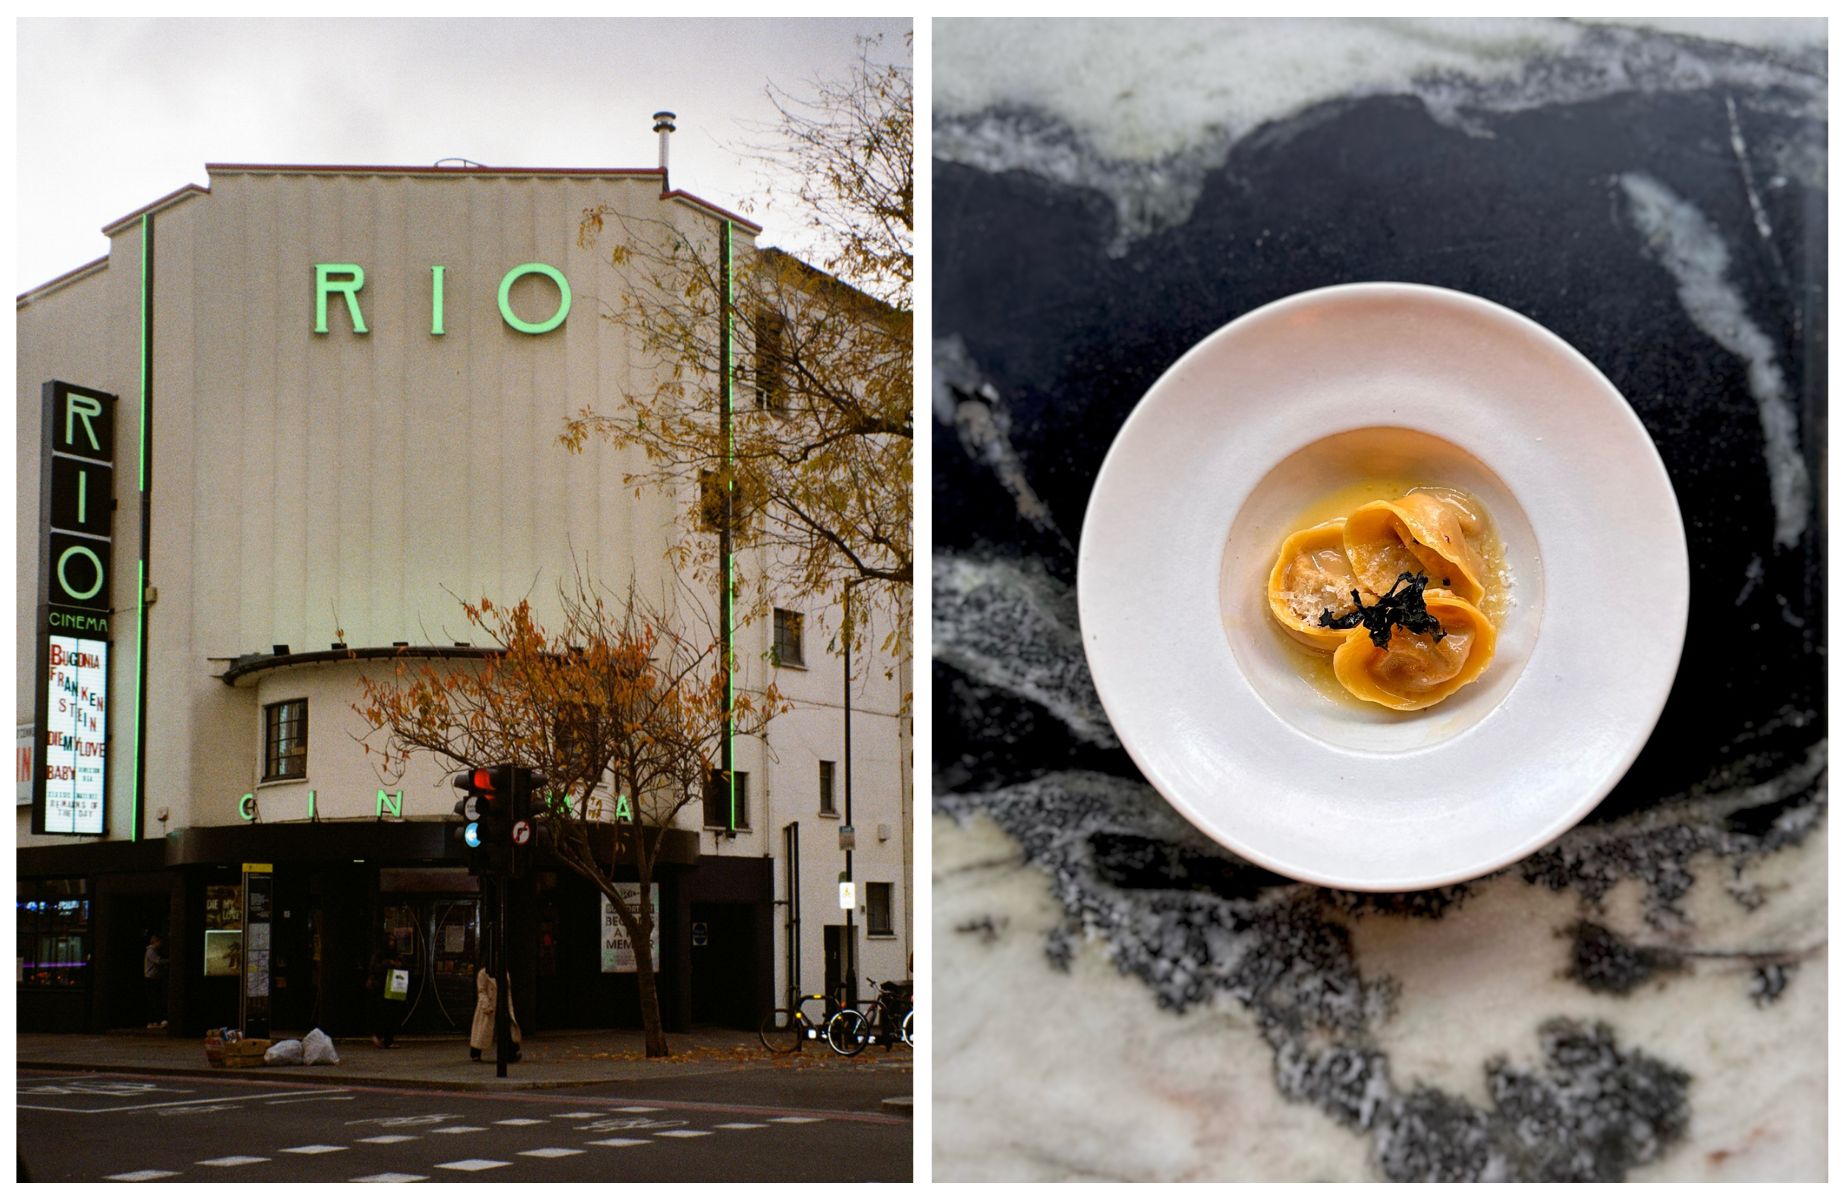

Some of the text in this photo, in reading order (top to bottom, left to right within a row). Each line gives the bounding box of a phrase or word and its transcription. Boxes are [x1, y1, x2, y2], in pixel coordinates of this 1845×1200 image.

[313, 263, 572, 335] RIO
[56, 392, 104, 600] RIO
[48, 612, 108, 632] CINEMA
[50, 644, 100, 669] BUGONIA
[47, 765, 75, 780] BABY
[606, 939, 654, 949] MEMR
